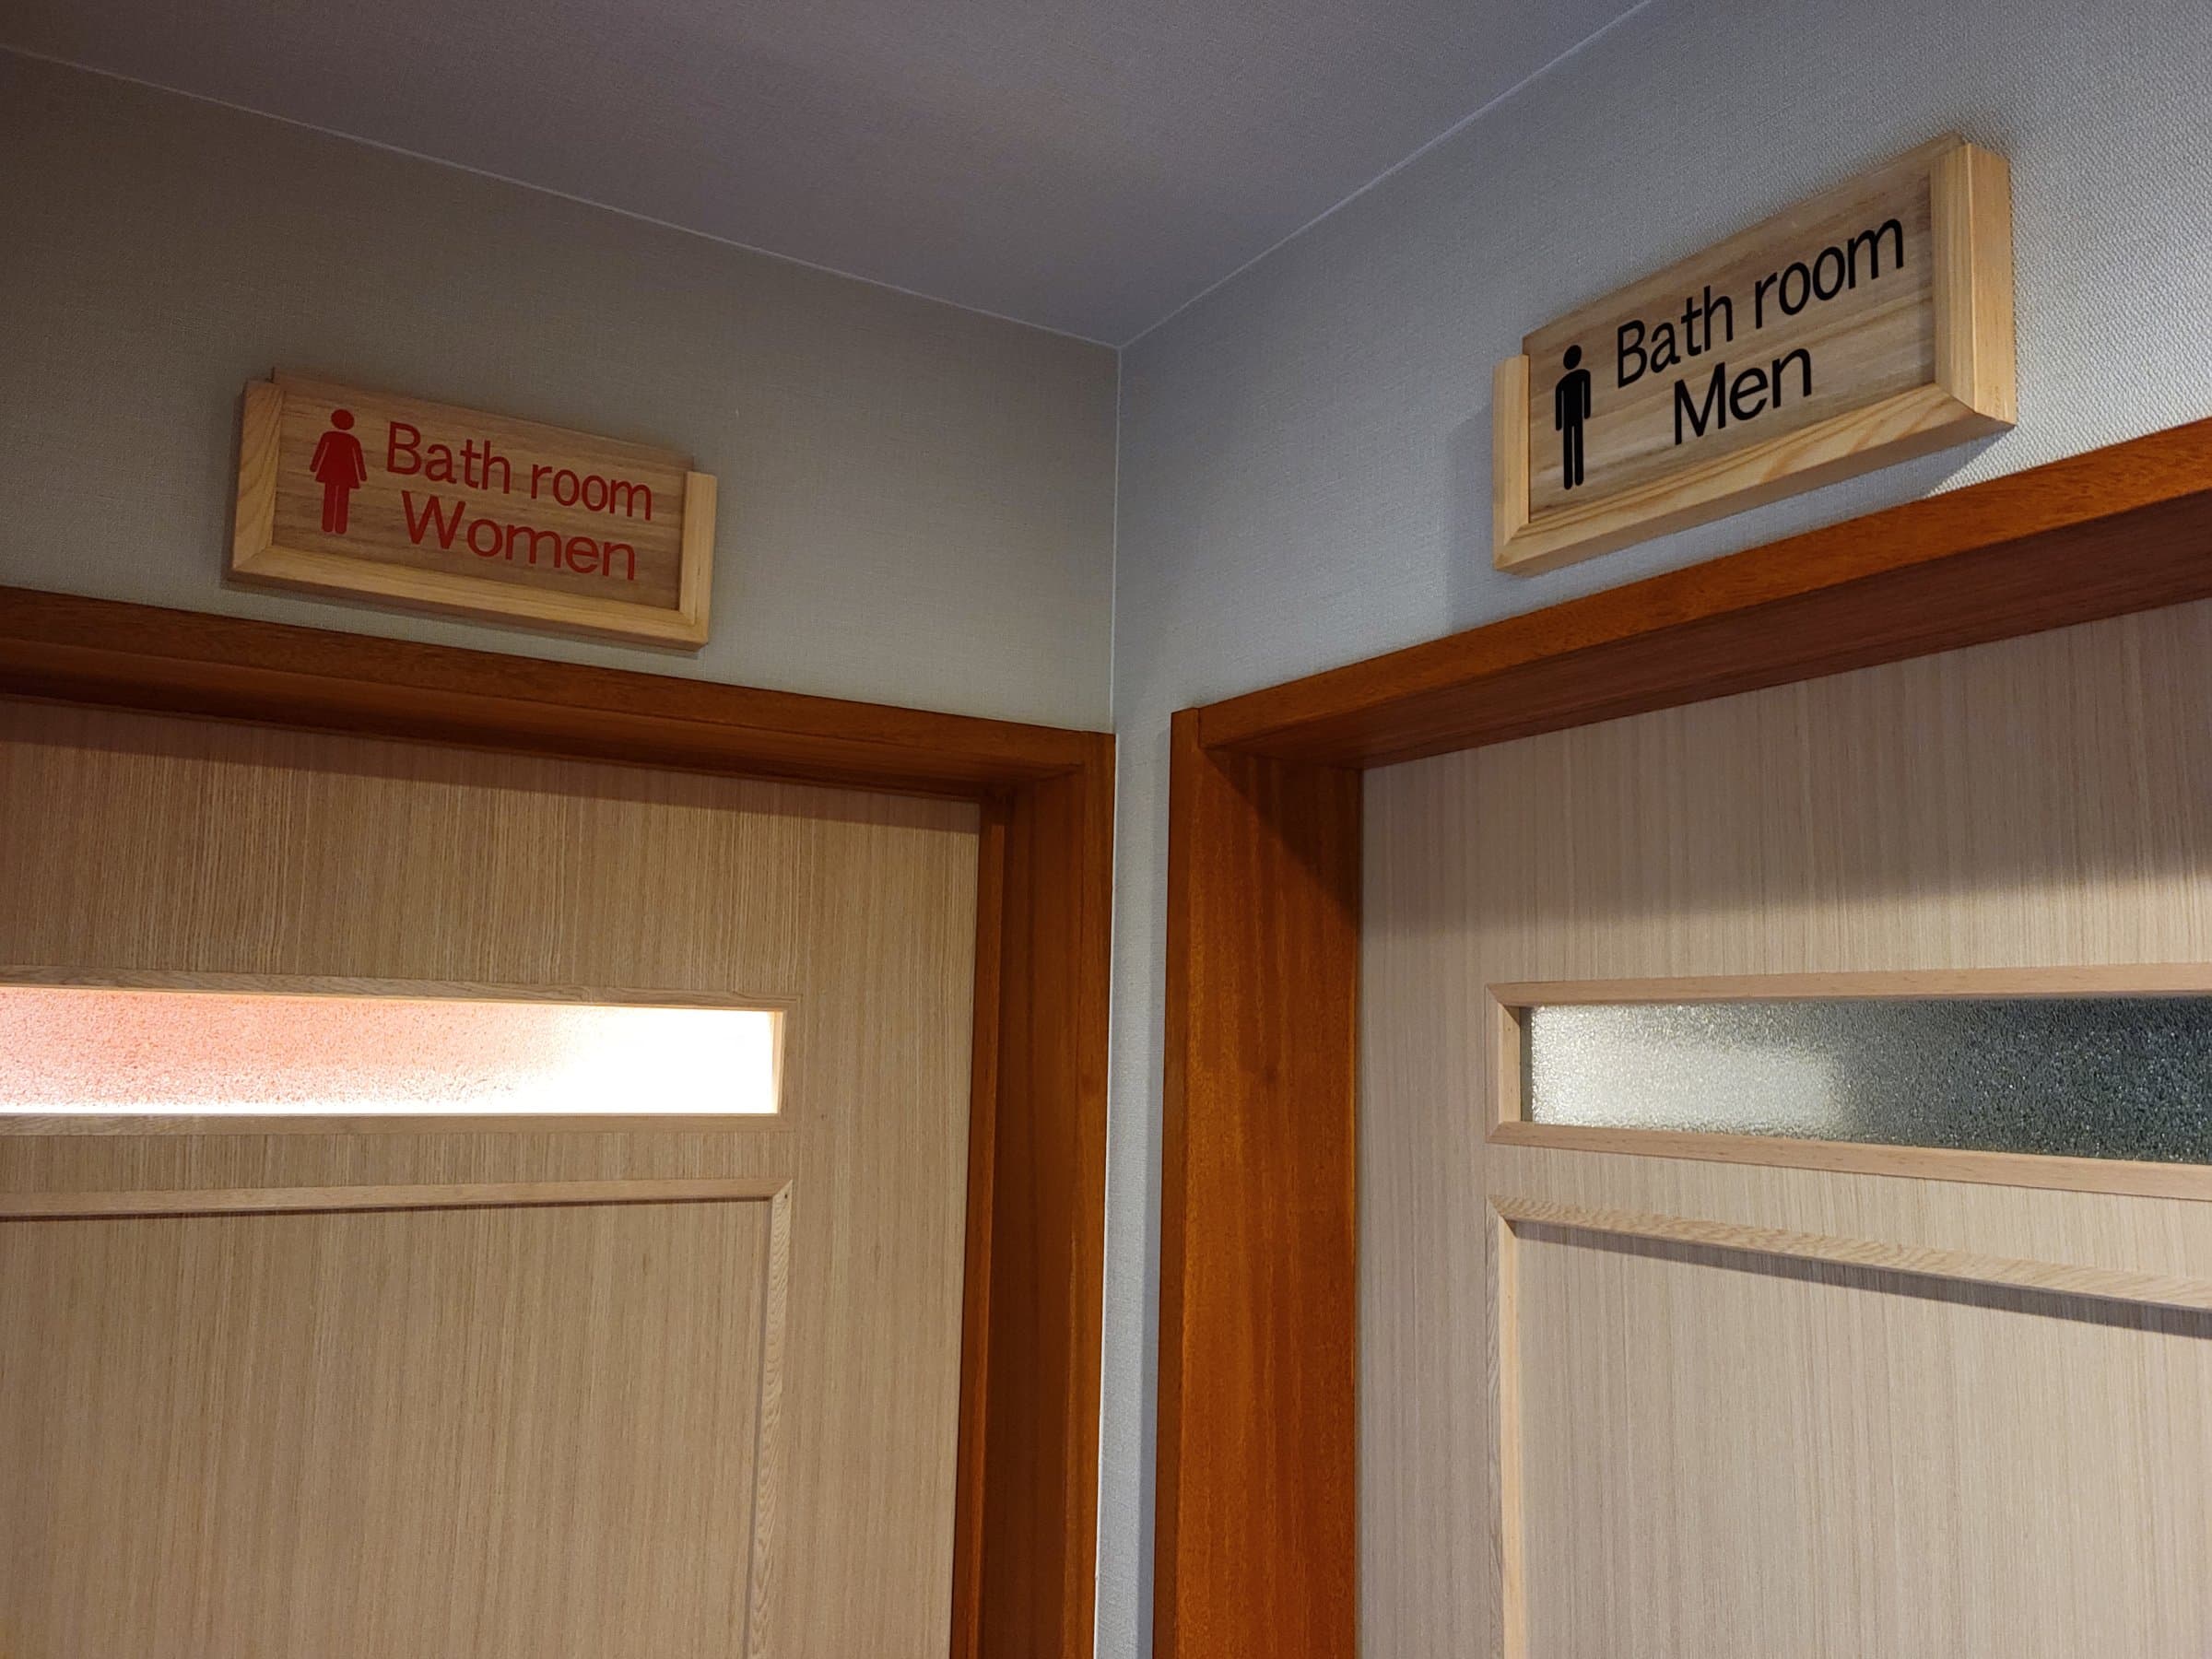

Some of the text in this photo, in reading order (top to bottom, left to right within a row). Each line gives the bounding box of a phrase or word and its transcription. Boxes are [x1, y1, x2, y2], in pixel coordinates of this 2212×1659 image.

[1617, 218, 1904, 389] Bath room
[1674, 347, 1812, 445] Men
[387, 421, 653, 521] Bath room
[401, 490, 635, 581] Women
